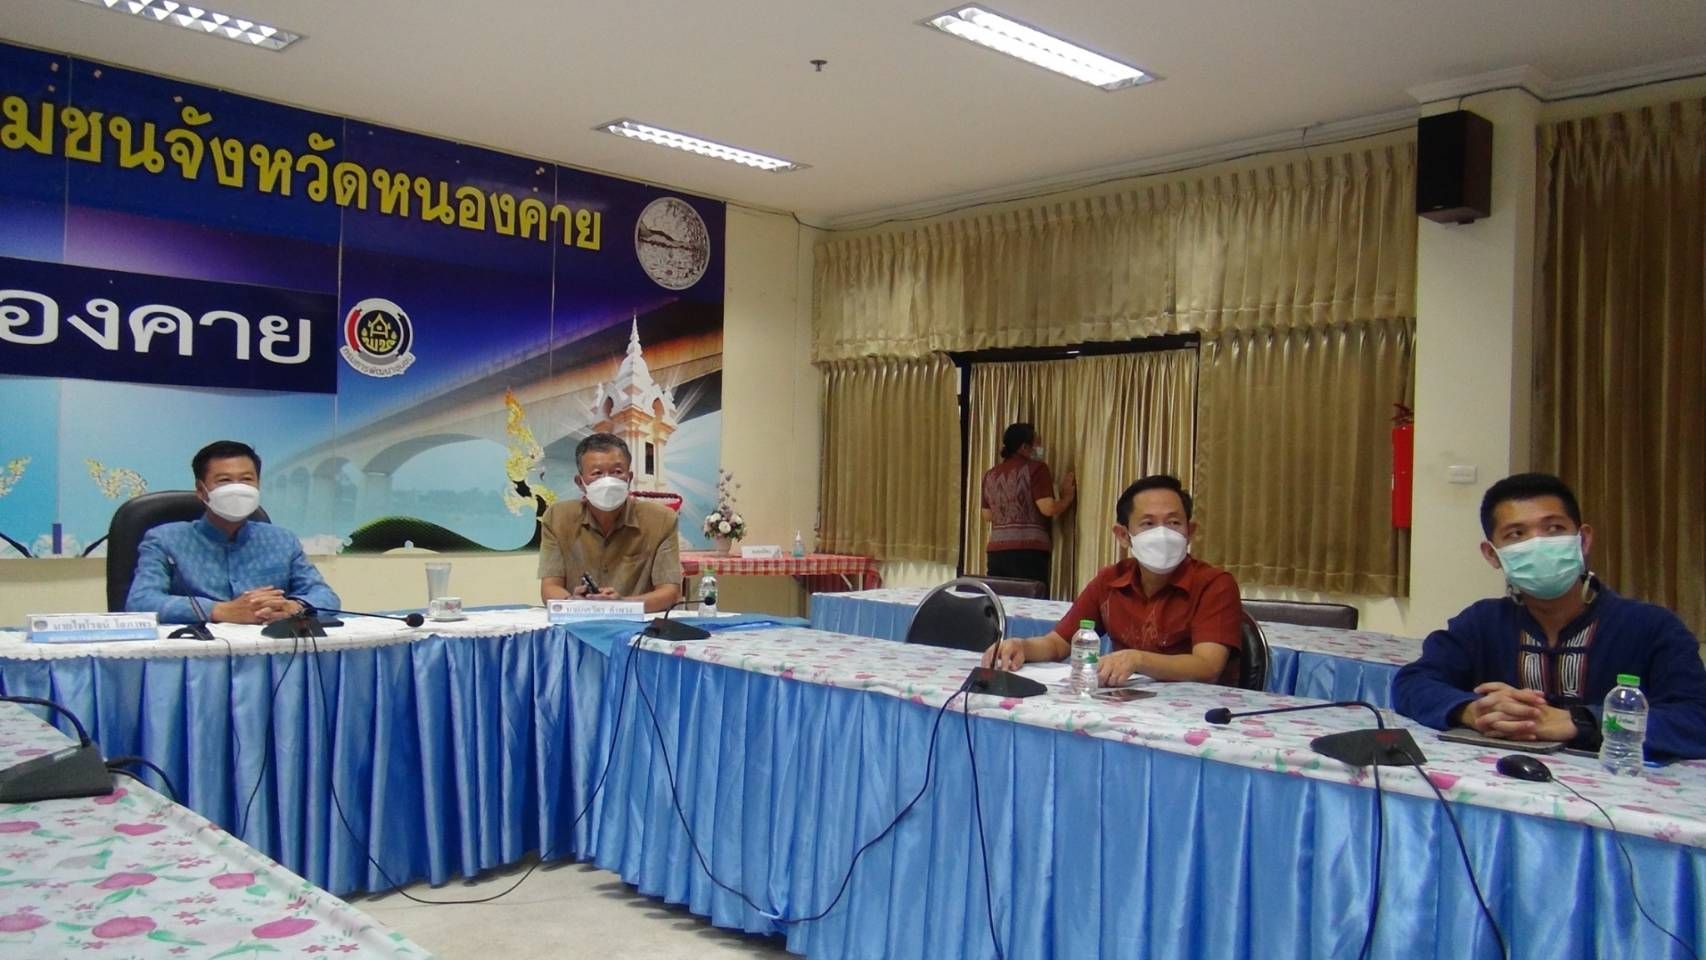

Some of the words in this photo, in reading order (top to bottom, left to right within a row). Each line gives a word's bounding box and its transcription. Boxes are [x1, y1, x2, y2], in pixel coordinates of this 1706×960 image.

[1, 95, 602, 251] มชนจังหวัดหนองคาย
[0, 288, 312, 365] องคาย
